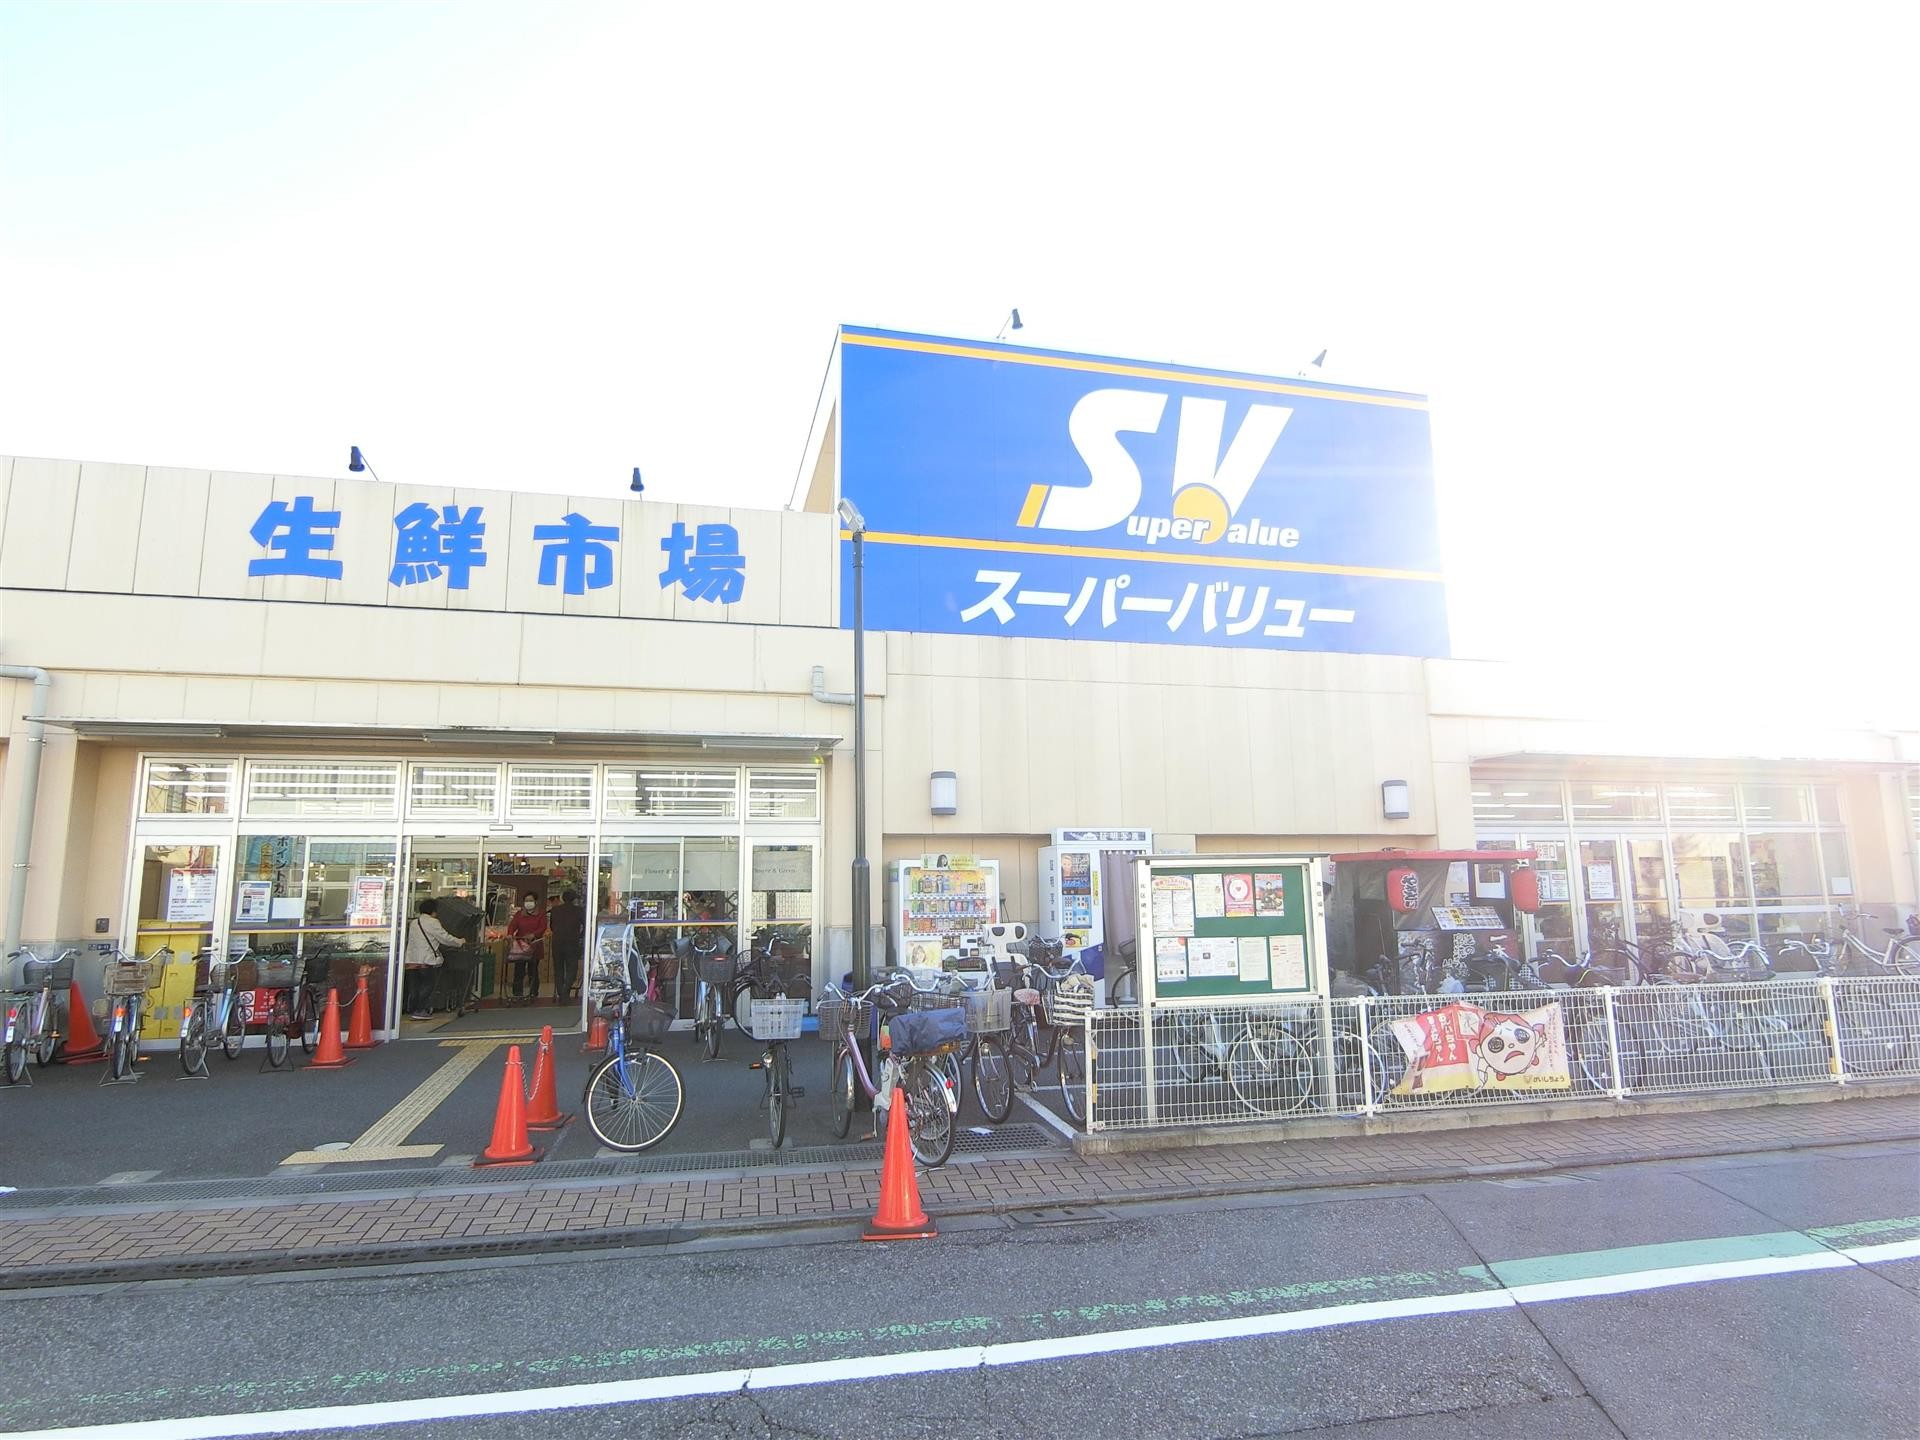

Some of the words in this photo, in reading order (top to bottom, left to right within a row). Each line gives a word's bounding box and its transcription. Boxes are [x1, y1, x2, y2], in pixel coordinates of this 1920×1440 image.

[248, 496, 746, 604] 生鮮市場
[960, 569, 1356, 639] スーパーバリュー
[273, 836, 289, 897] ポイントカ
